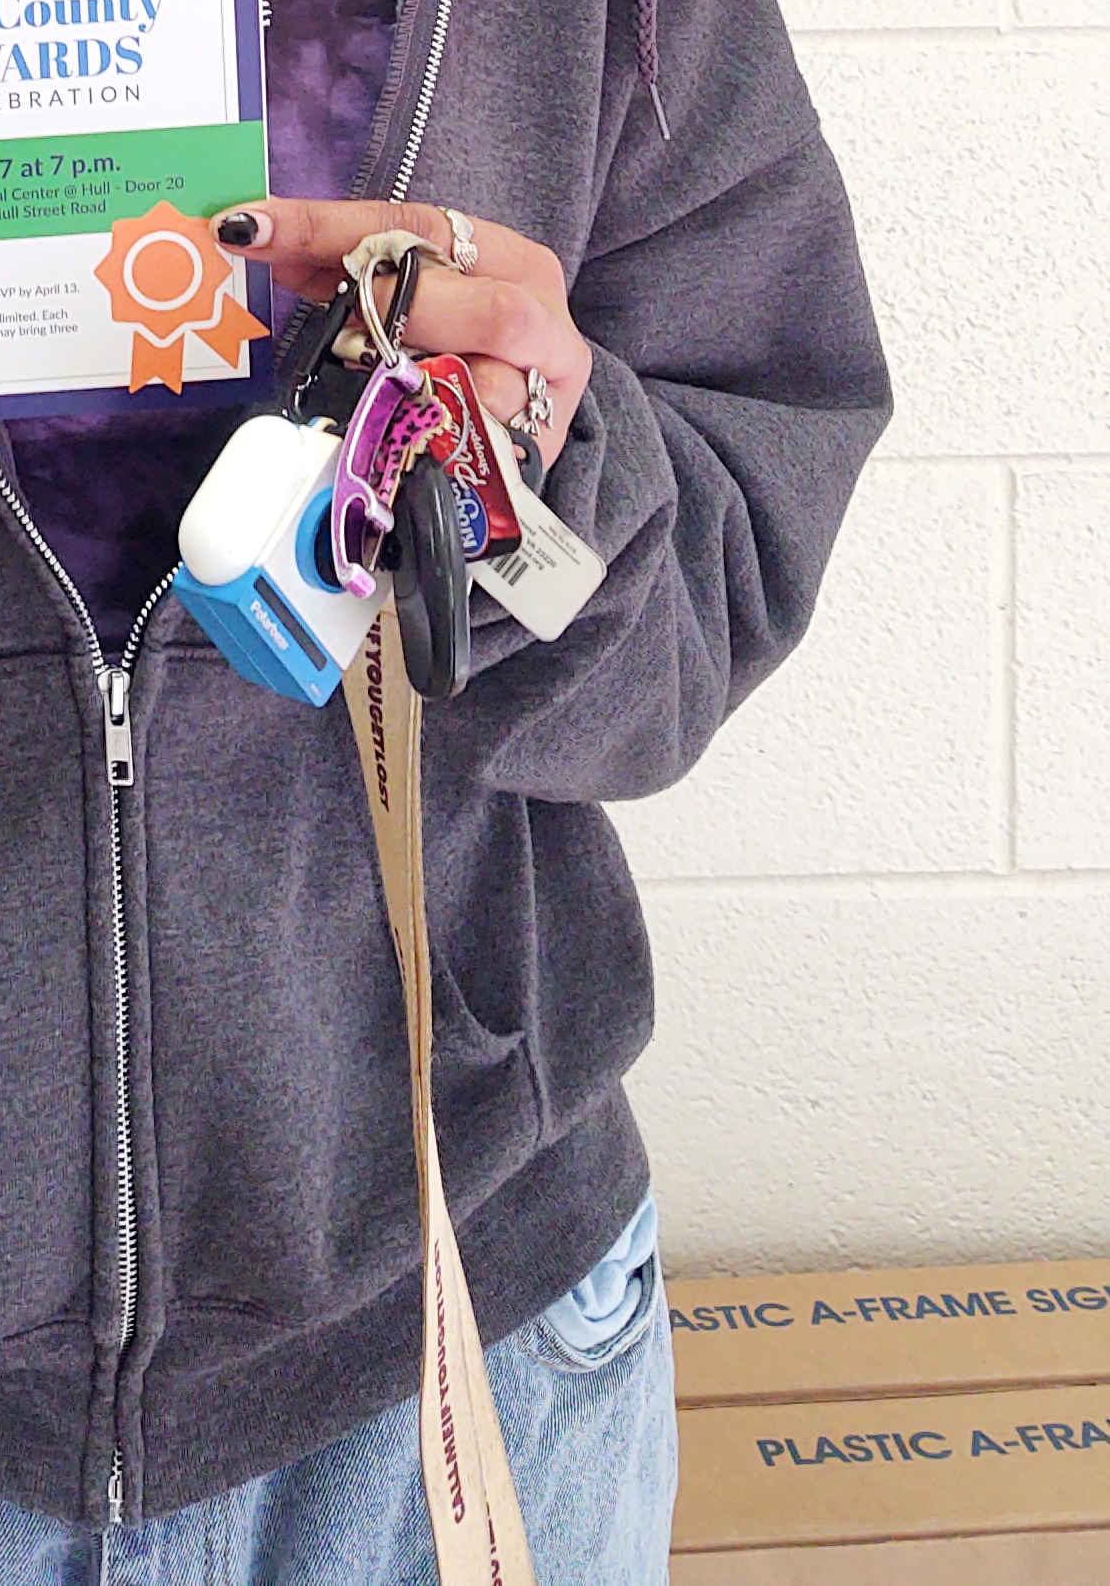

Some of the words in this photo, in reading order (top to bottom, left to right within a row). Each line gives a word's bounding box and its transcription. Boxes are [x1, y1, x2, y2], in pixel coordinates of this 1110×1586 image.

[20, 158, 43, 177] at
[50, 155, 64, 175] 7
[72, 156, 121, 179] p.m.
[11, 185, 59, 201] Center
[64, 184, 78, 199] @
[82, 181, 111, 196] Hull
[125, 179, 162, 193] Door
[165, 176, 185, 190] 20
[23, 203, 65, 218] Street
[71, 199, 107, 214] Road
[19, 286, 31, 298] by
[35, 283, 60, 297] April
[0, 310, 39, 324] limited.
[42, 309, 68, 320] Each
[19, 324, 47, 337] bring
[50, 323, 79, 334] three
[365, 611, 390, 813] IFYOUGETLOST
[810, 1290, 1018, 1326] A-FRAME
[1026, 1286, 1110, 1313] SIG
[756, 1430, 953, 1467] PLASTIC
[970, 1418, 1110, 1459] A-FRA
